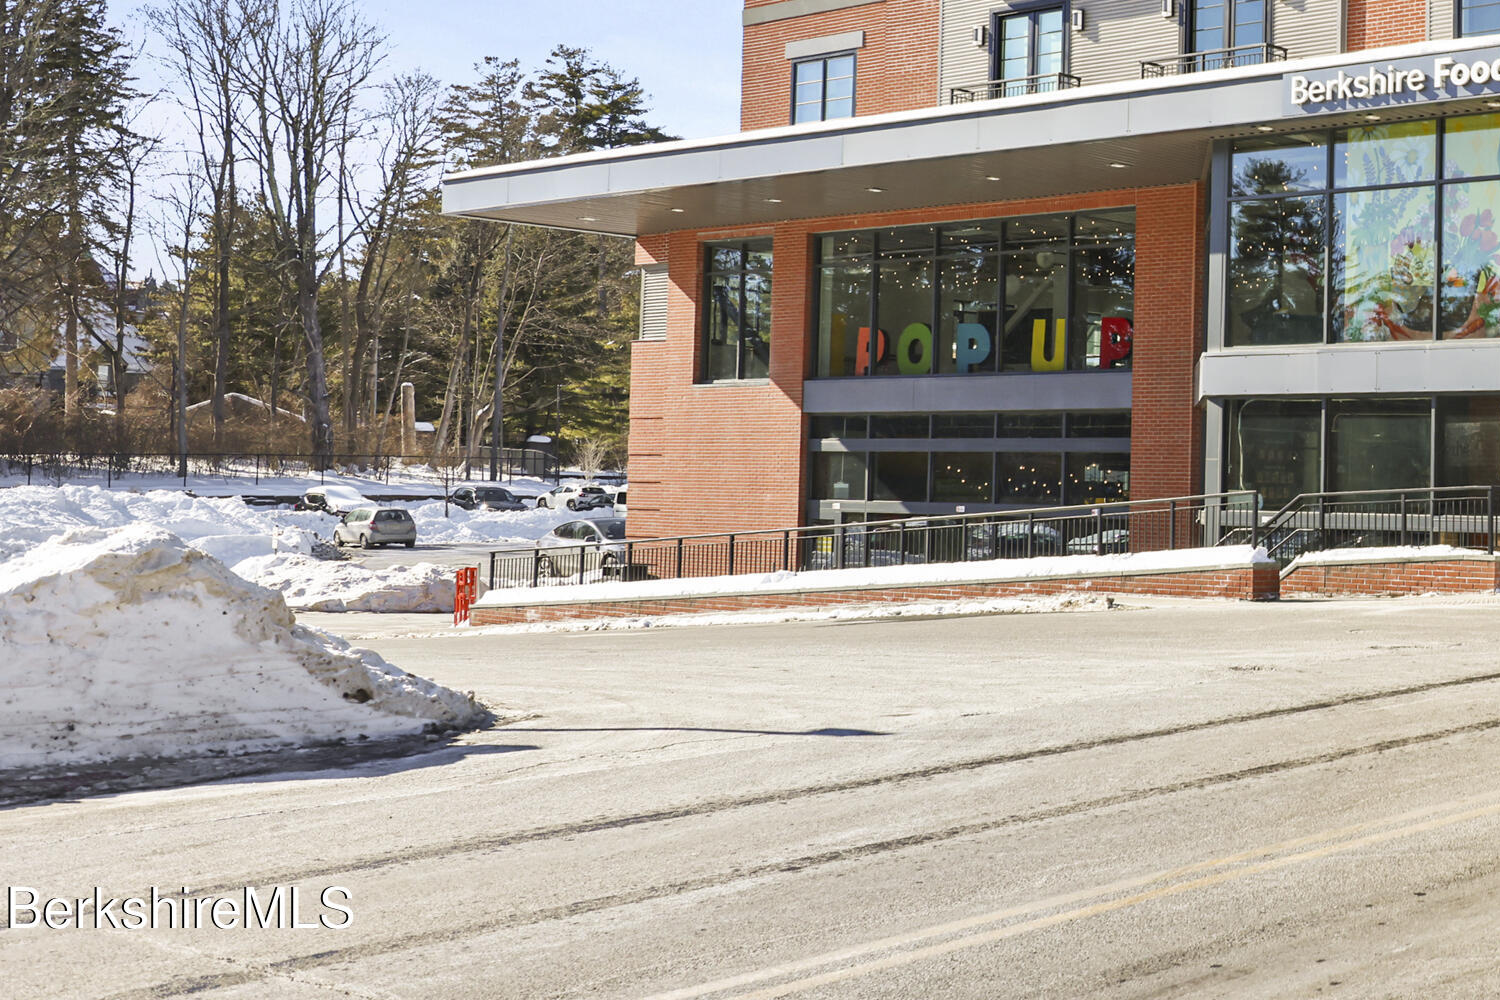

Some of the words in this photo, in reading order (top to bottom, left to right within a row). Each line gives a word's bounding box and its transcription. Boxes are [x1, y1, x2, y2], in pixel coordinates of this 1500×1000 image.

[1291, 64, 1426, 105] Berkshire
[855, 322, 992, 376] POP
[1031, 317, 1133, 372] UP
